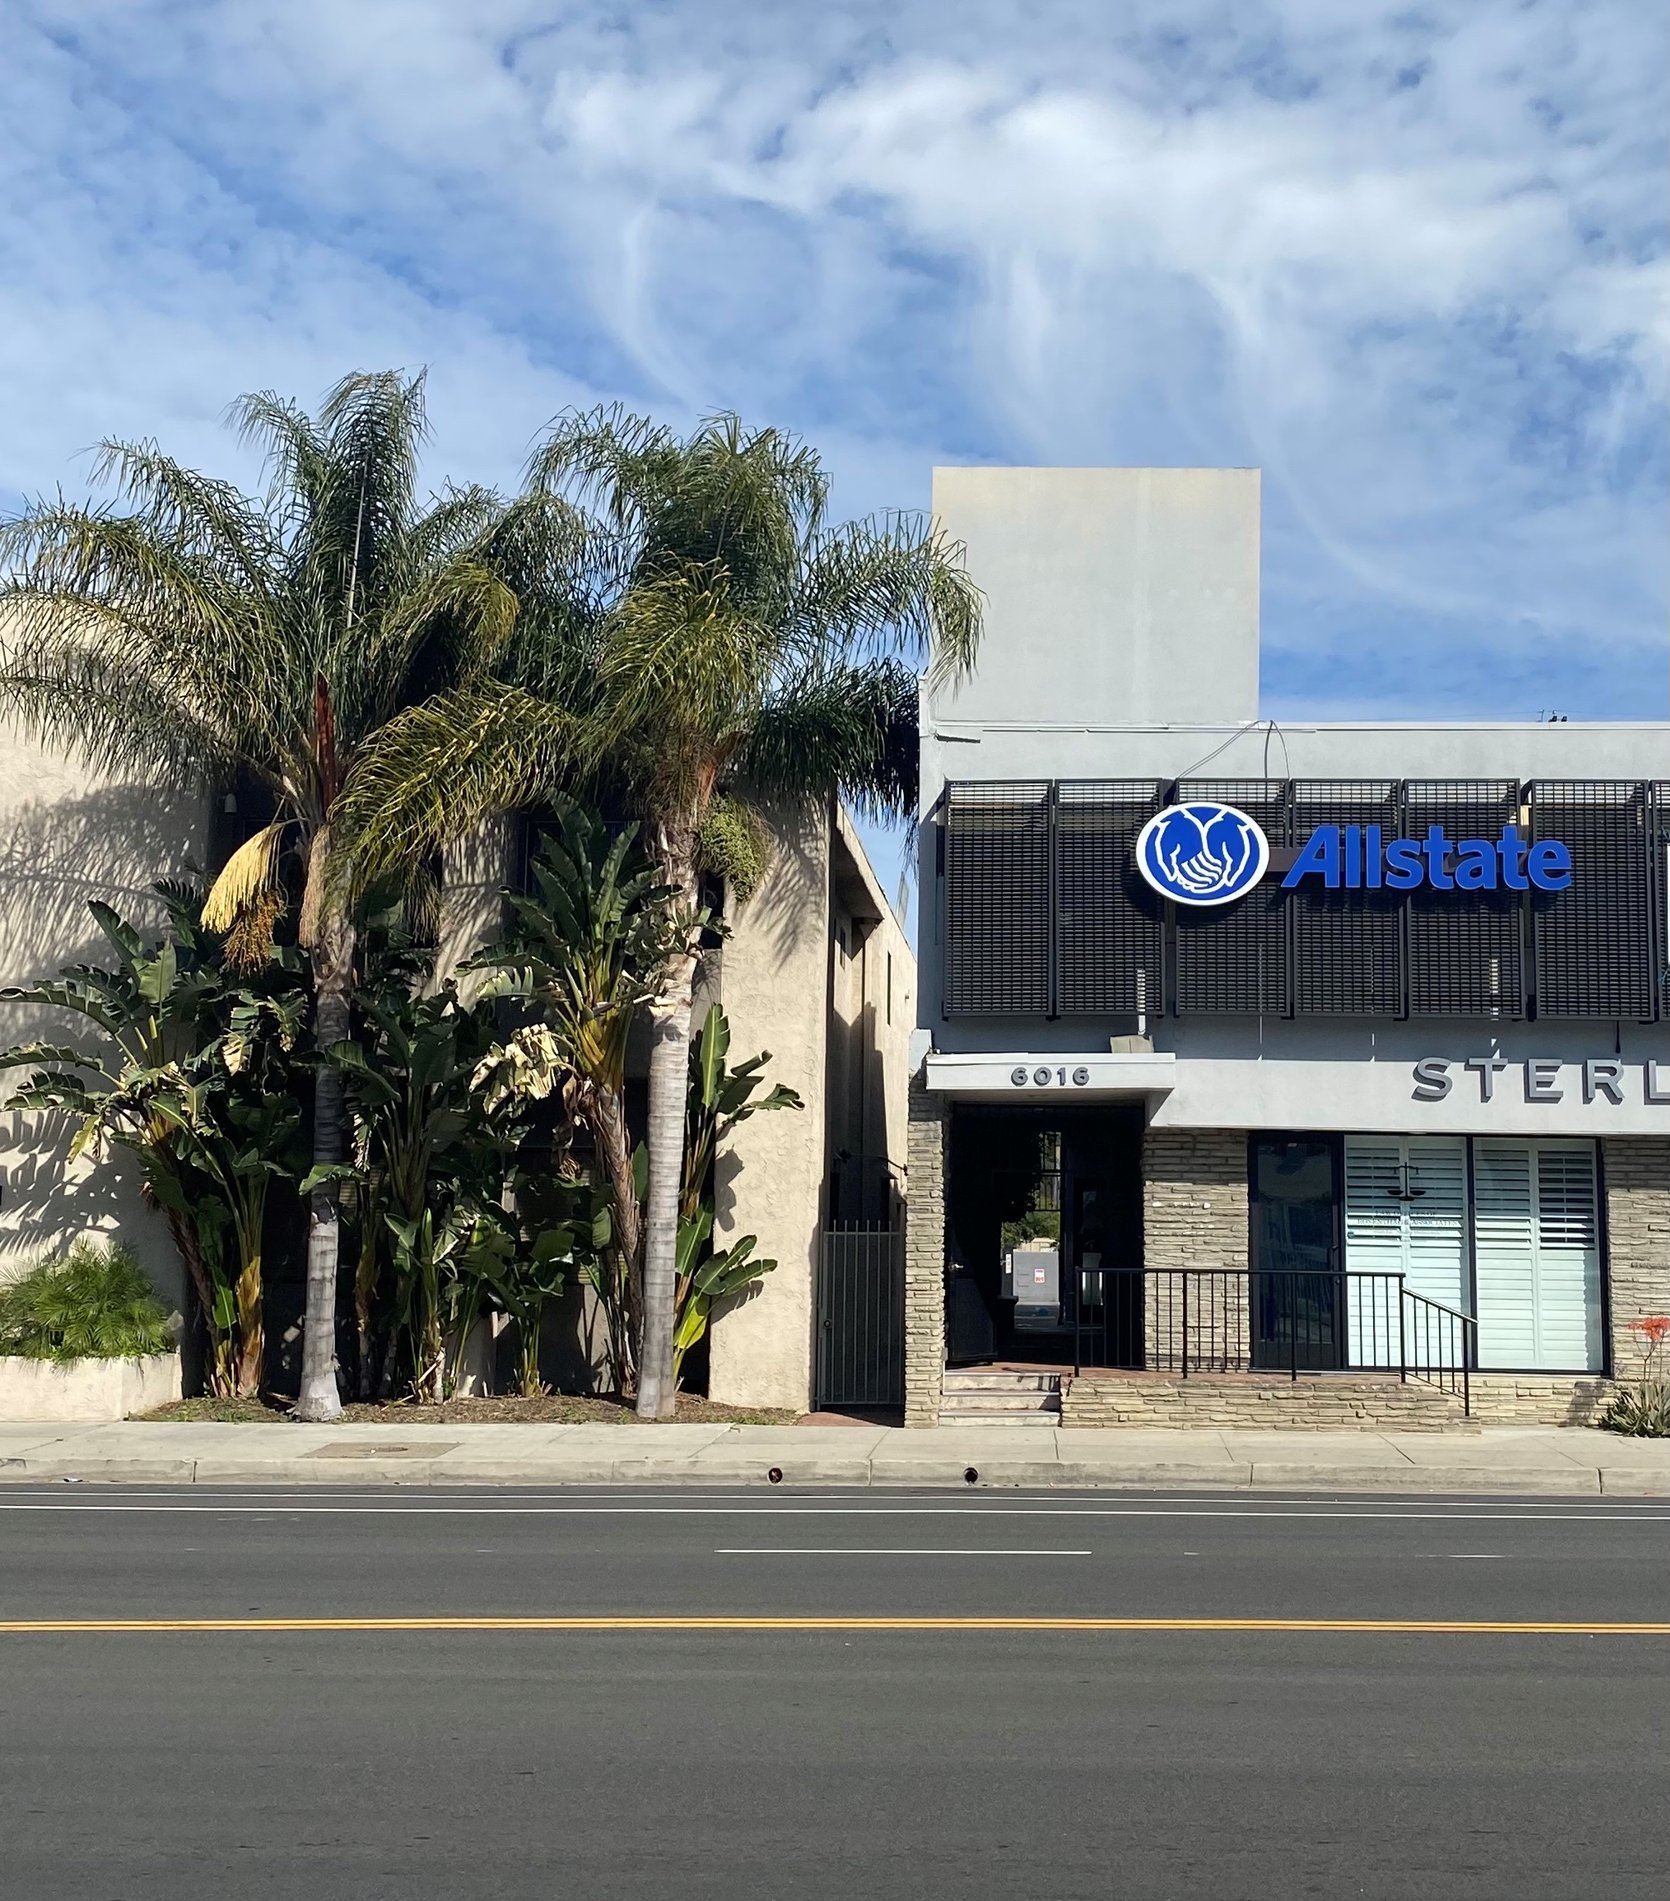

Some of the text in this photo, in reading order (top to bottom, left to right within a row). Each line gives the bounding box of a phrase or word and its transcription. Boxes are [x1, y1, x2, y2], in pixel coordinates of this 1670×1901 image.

[1280, 825, 1572, 890] Allstate
[1011, 1066, 1090, 1087] 6016
[1411, 1056, 1670, 1105] STERL
